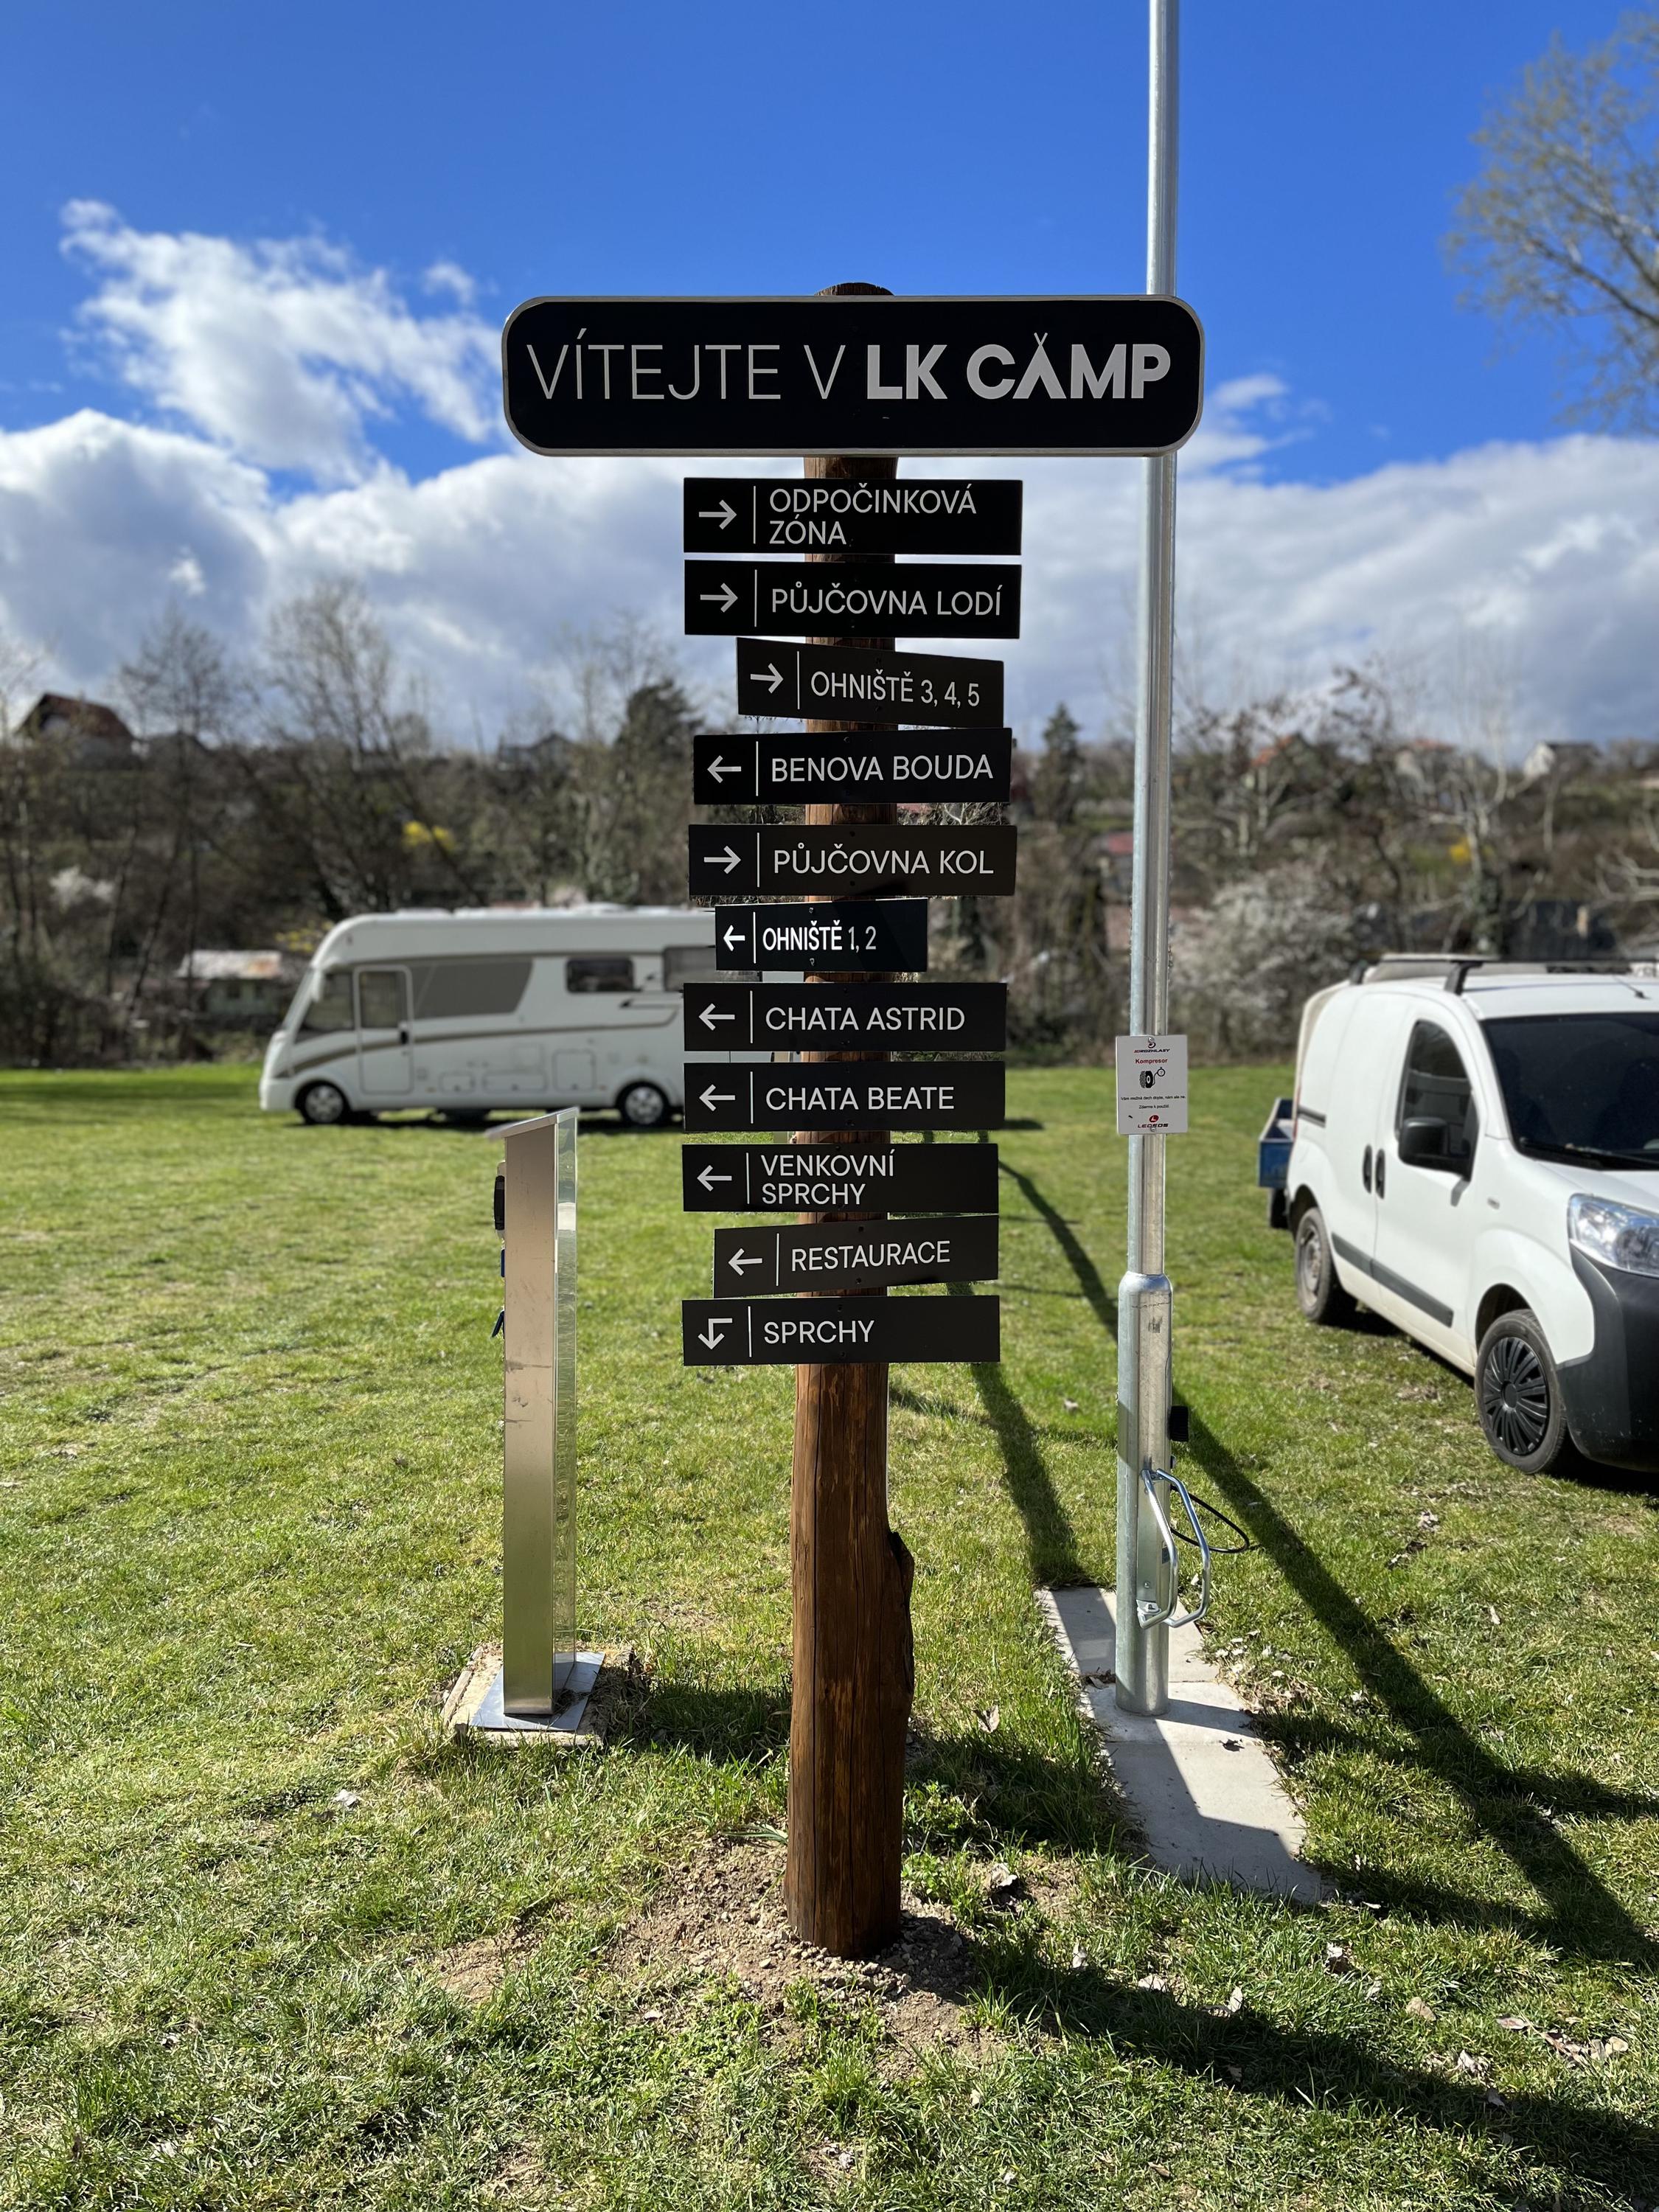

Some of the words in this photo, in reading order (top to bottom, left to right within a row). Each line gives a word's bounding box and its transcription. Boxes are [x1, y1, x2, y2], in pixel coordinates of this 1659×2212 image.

[527, 328, 780, 399] VÍTEJTE
[804, 345, 846, 399] V
[867, 345, 947, 399] LK
[967, 333, 1170, 399] CAMP
[771, 483, 976, 513] ODPOČINKOVÁ
[770, 514, 846, 544] ZÓNA
[773, 582, 927, 614] PŮJČOVNA
[938, 585, 1002, 615] LODÍ
[811, 669, 913, 702] OHNIŠTĚ
[921, 680, 937, 706] 3,
[945, 682, 960, 708] 4,
[968, 684, 979, 706] 5
[773, 757, 883, 782] BENOVA
[894, 754, 993, 779] BOUDA
[775, 843, 930, 874] PŮJČOVNA
[940, 851, 993, 874] KOL
[763, 920, 842, 950] OHNIŠTĚ
[849, 927, 859, 953] 1,
[866, 926, 876, 950] 2
[766, 1007, 858, 1030] CHATA
[866, 1008, 964, 1030] ASTRID
[766, 1088, 858, 1110] CHATA
[869, 1087, 954, 1109] BEATE
[761, 1150, 894, 1176] VENKOVNÍ
[762, 1183, 866, 1204] SPRCHY
[792, 1241, 950, 1271] RESTAURACE
[765, 1321, 874, 1343] SPRCHY
